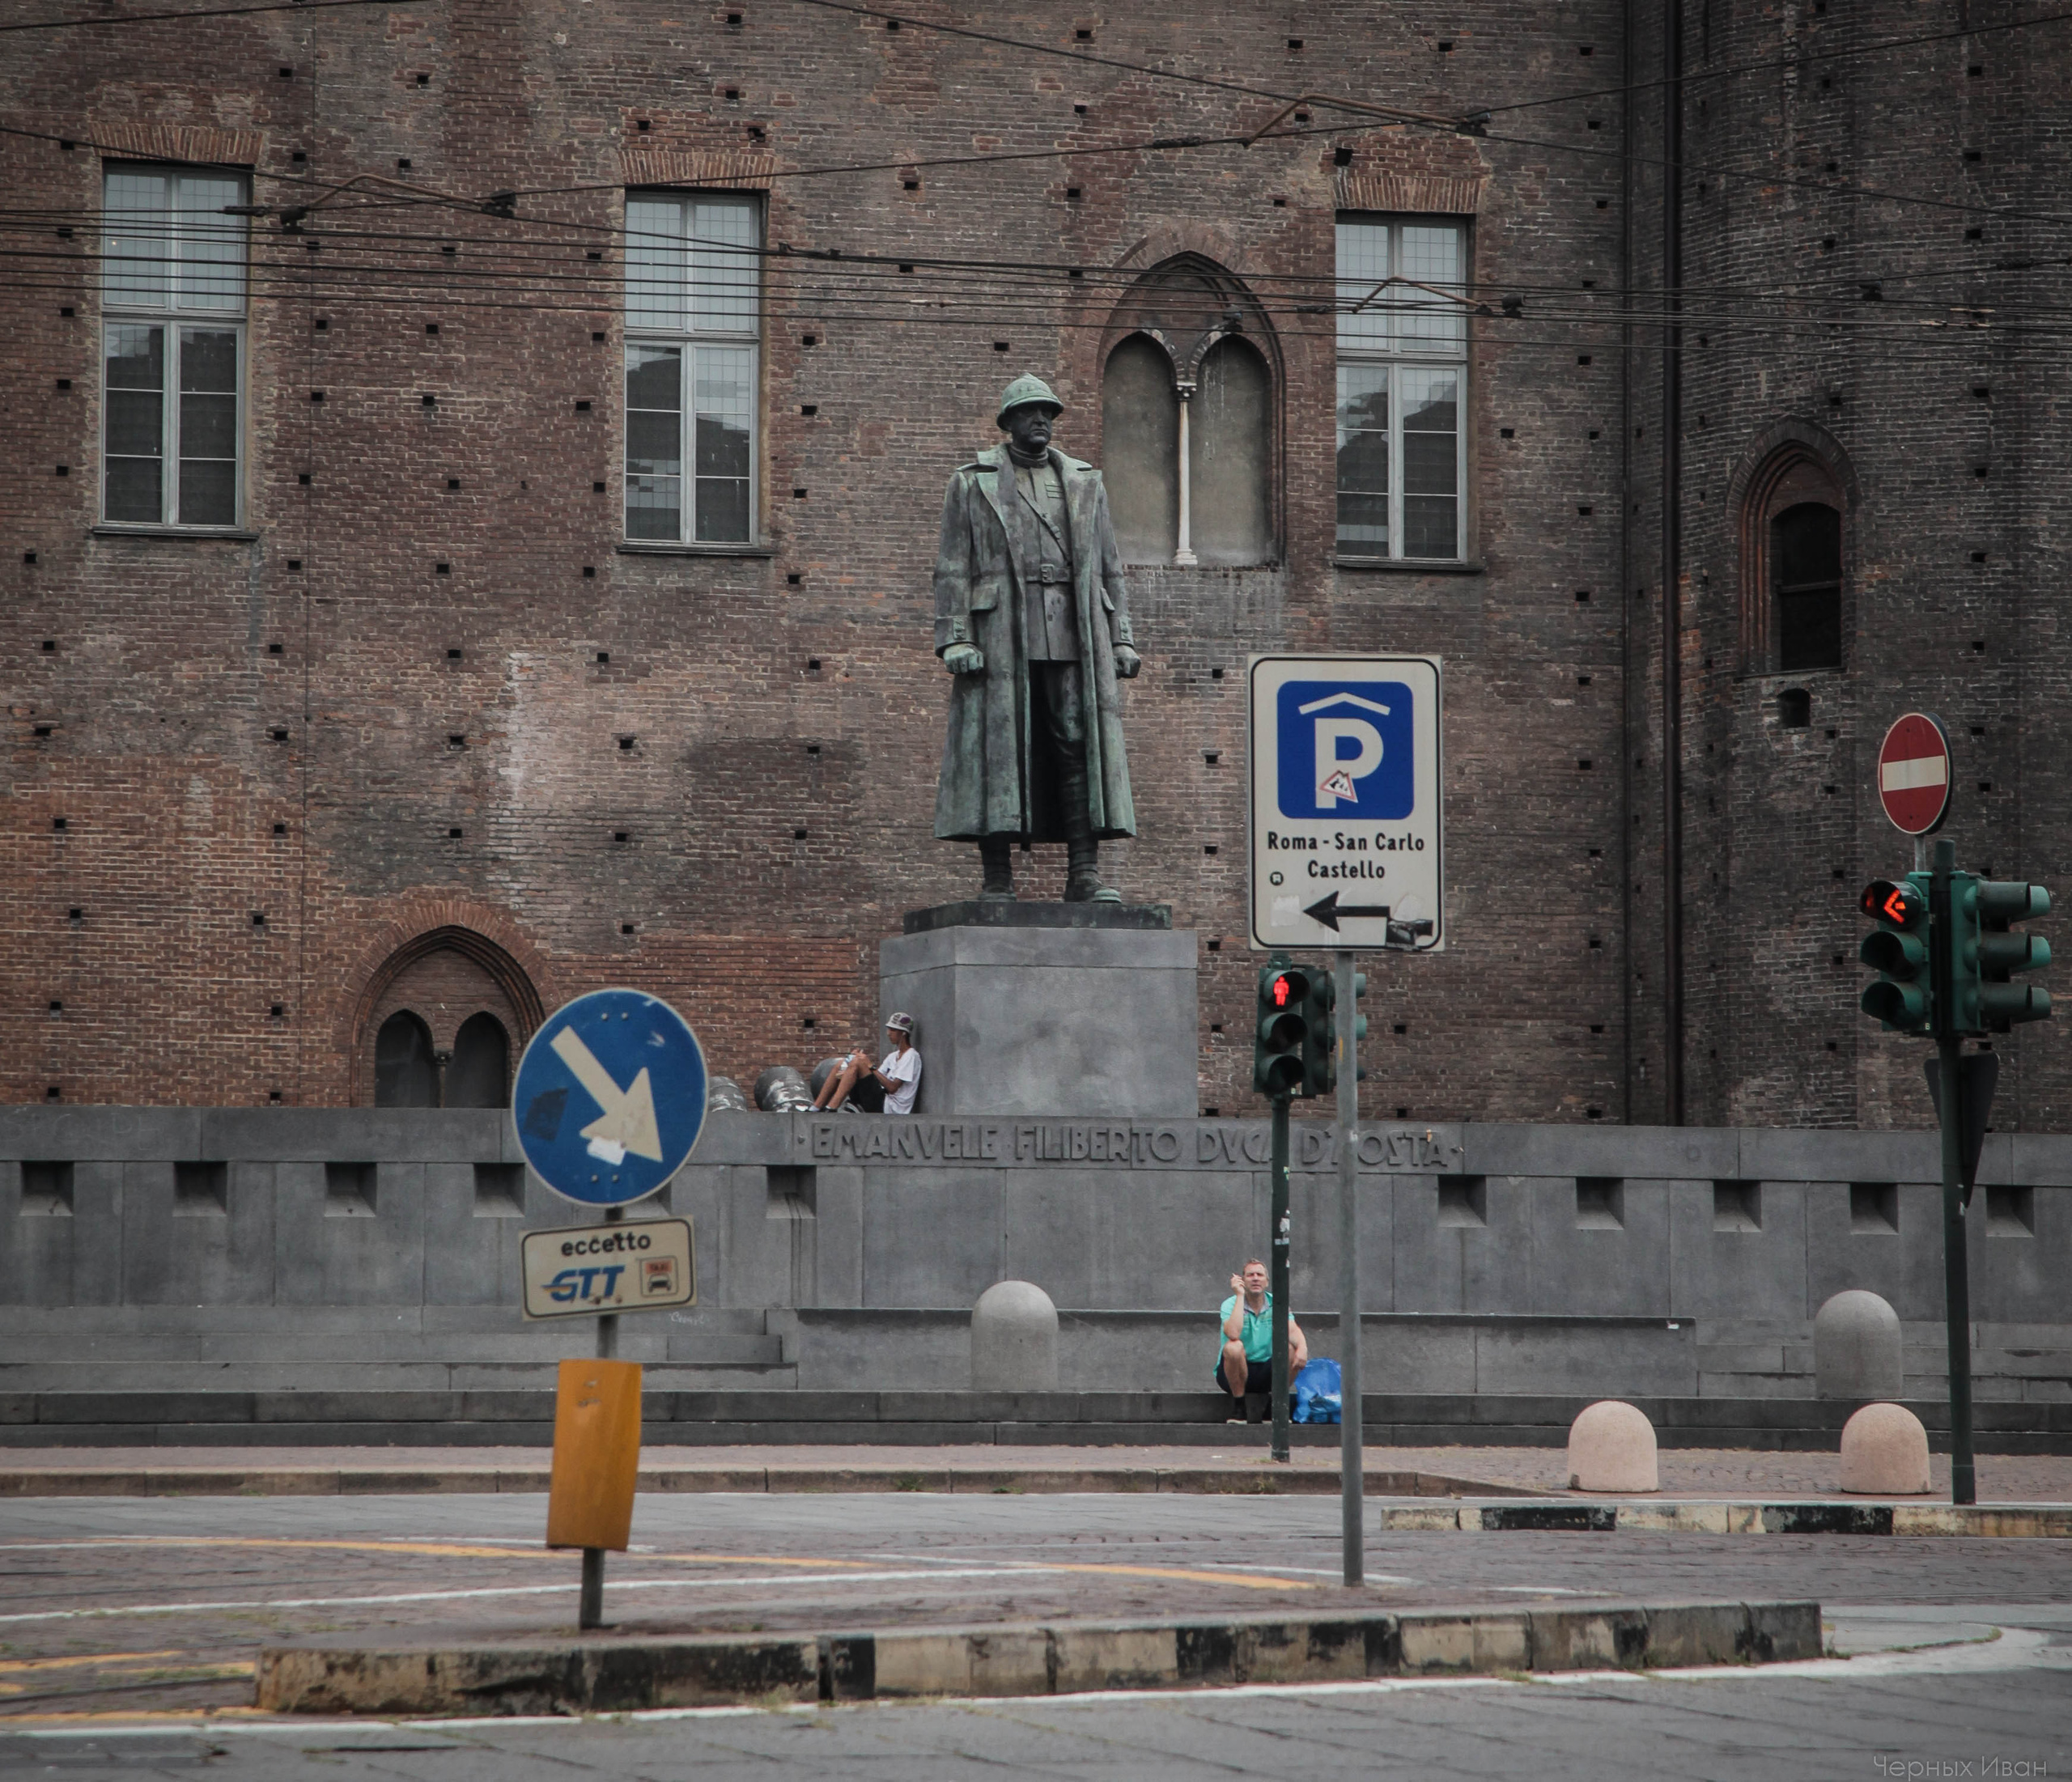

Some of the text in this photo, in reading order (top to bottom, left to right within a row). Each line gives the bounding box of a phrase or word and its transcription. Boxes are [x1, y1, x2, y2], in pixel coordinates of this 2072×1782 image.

[1314, 717, 1383, 808] P
[1267, 831, 1317, 851] Roma
[1335, 832, 1367, 851] San
[1375, 833, 1424, 851] Carlo
[1308, 859, 1385, 879] Castello
[813, 1124, 997, 1160] EMANVELE
[1016, 1126, 1182, 1162] FILIBERTO
[1301, 1129, 1448, 1167] D'OSTA
[561, 1232, 652, 1257] eccetto
[541, 1266, 624, 1302] GTT
